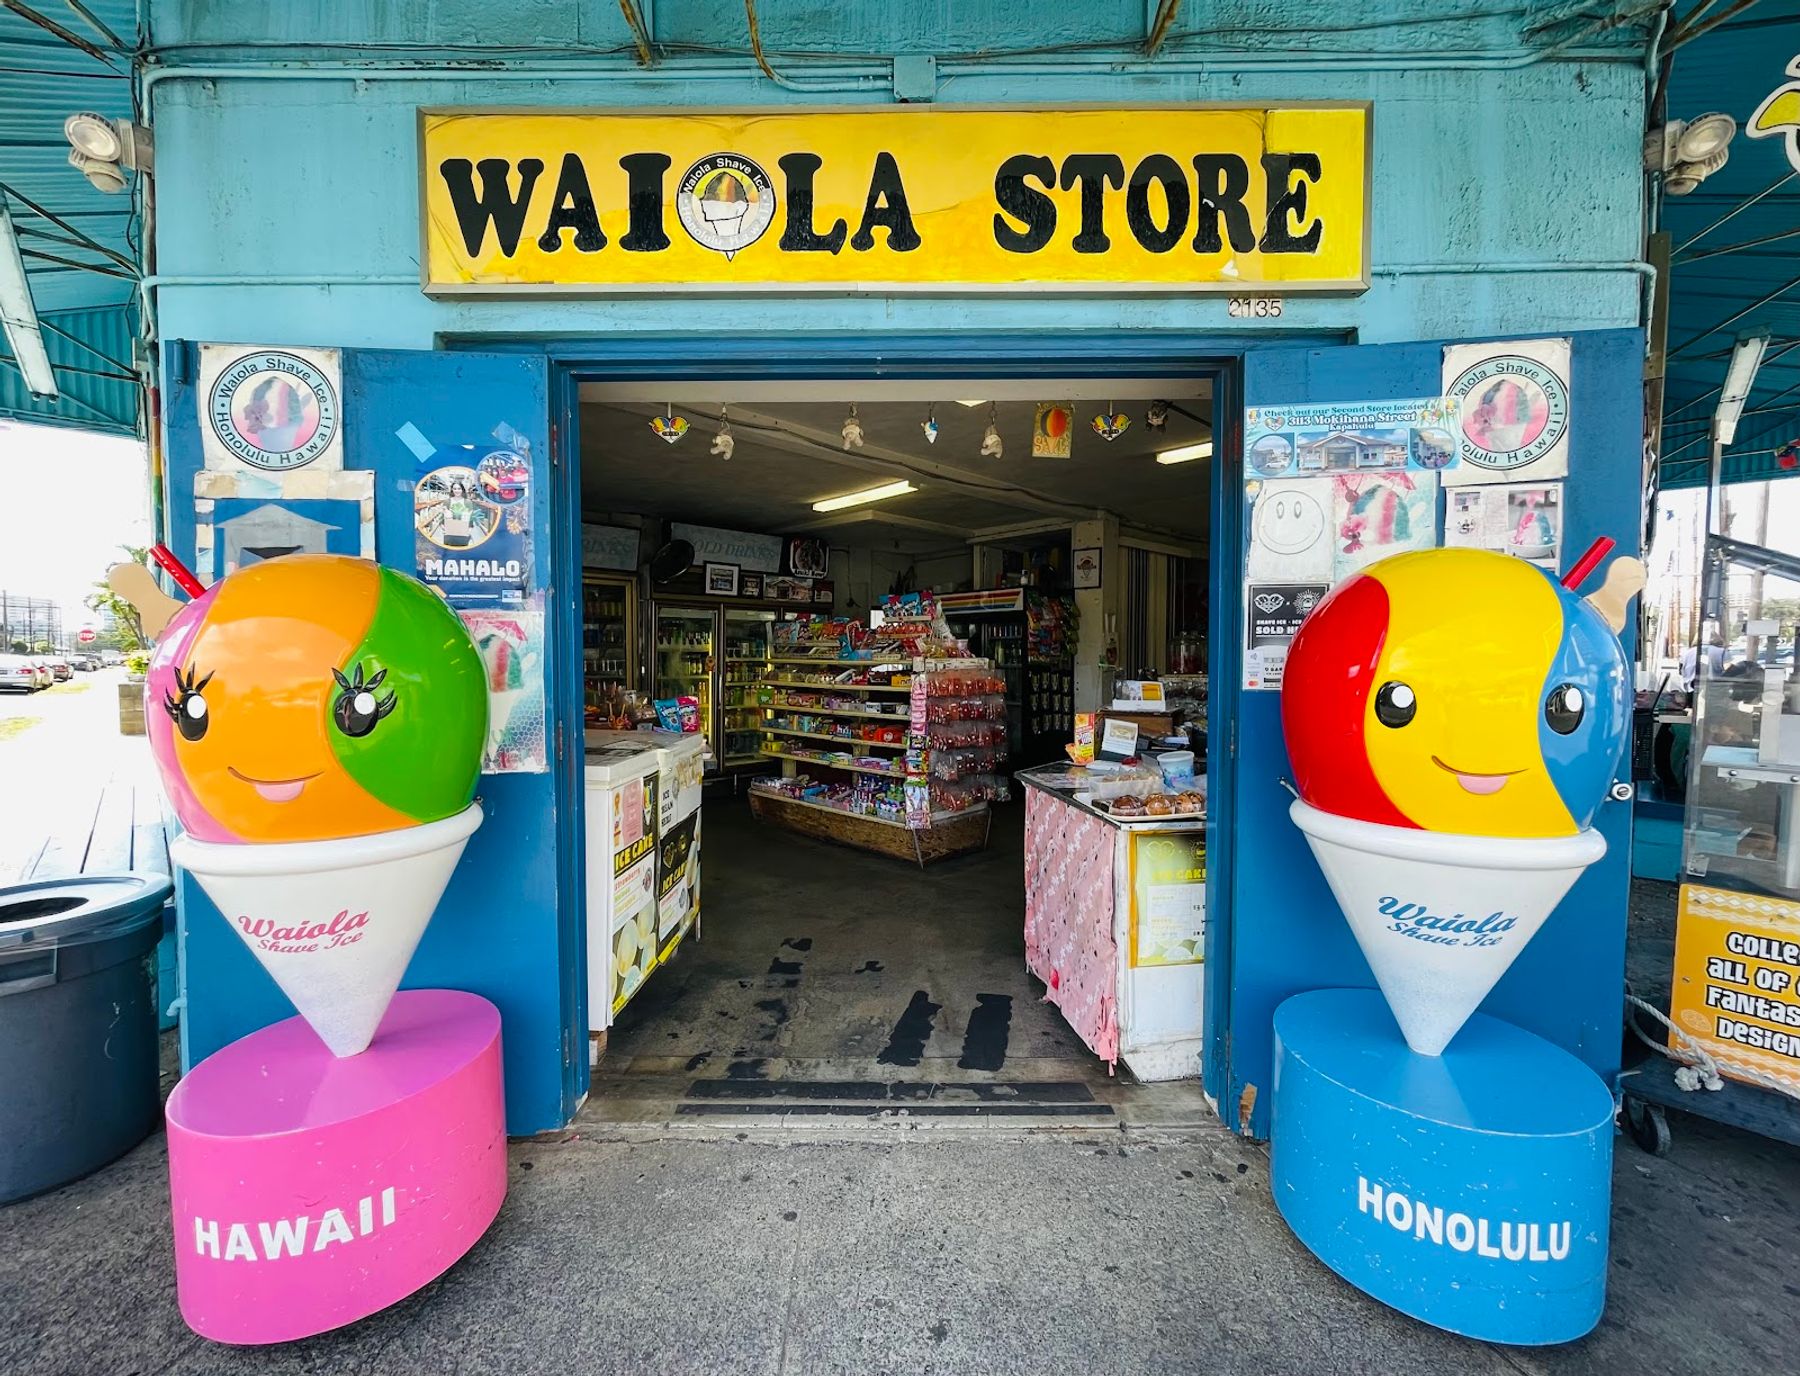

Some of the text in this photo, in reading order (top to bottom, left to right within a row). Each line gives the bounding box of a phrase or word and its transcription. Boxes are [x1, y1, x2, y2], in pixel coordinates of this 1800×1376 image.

[683, 157, 767, 194] Waiola Shave Ice
[993, 153, 1323, 254] STORE
[1229, 299, 1282, 318] 2135
[218, 358, 328, 403] Waiola Shave Ice
[1454, 362, 1558, 400] aiola Shave Ice
[1264, 408, 1294, 417] Check
[1331, 405, 1365, 413] Second
[1393, 403, 1428, 411] located
[1288, 410, 1417, 426] 3113 Mokihana Street
[1329, 421, 1375, 433] Kapahulu
[216, 412, 333, 465] Honolulu Hawaii
[1461, 411, 1564, 464] olulu Hawaii
[425, 559, 520, 577] MAHALO
[1255, 626, 1284, 635] SOLD
[615, 832, 654, 872] ICE CAKE
[674, 860, 688, 882] CAK
[238, 909, 370, 940] Waiola
[1378, 896, 1519, 934] Waiola
[257, 932, 364, 953] Shave Ice
[1387, 922, 1504, 947] Shave Ice
[1726, 931, 1800, 966] COLLe
[195, 1186, 396, 1262] HAWAII
[1358, 1175, 1571, 1262] HONOLULU
